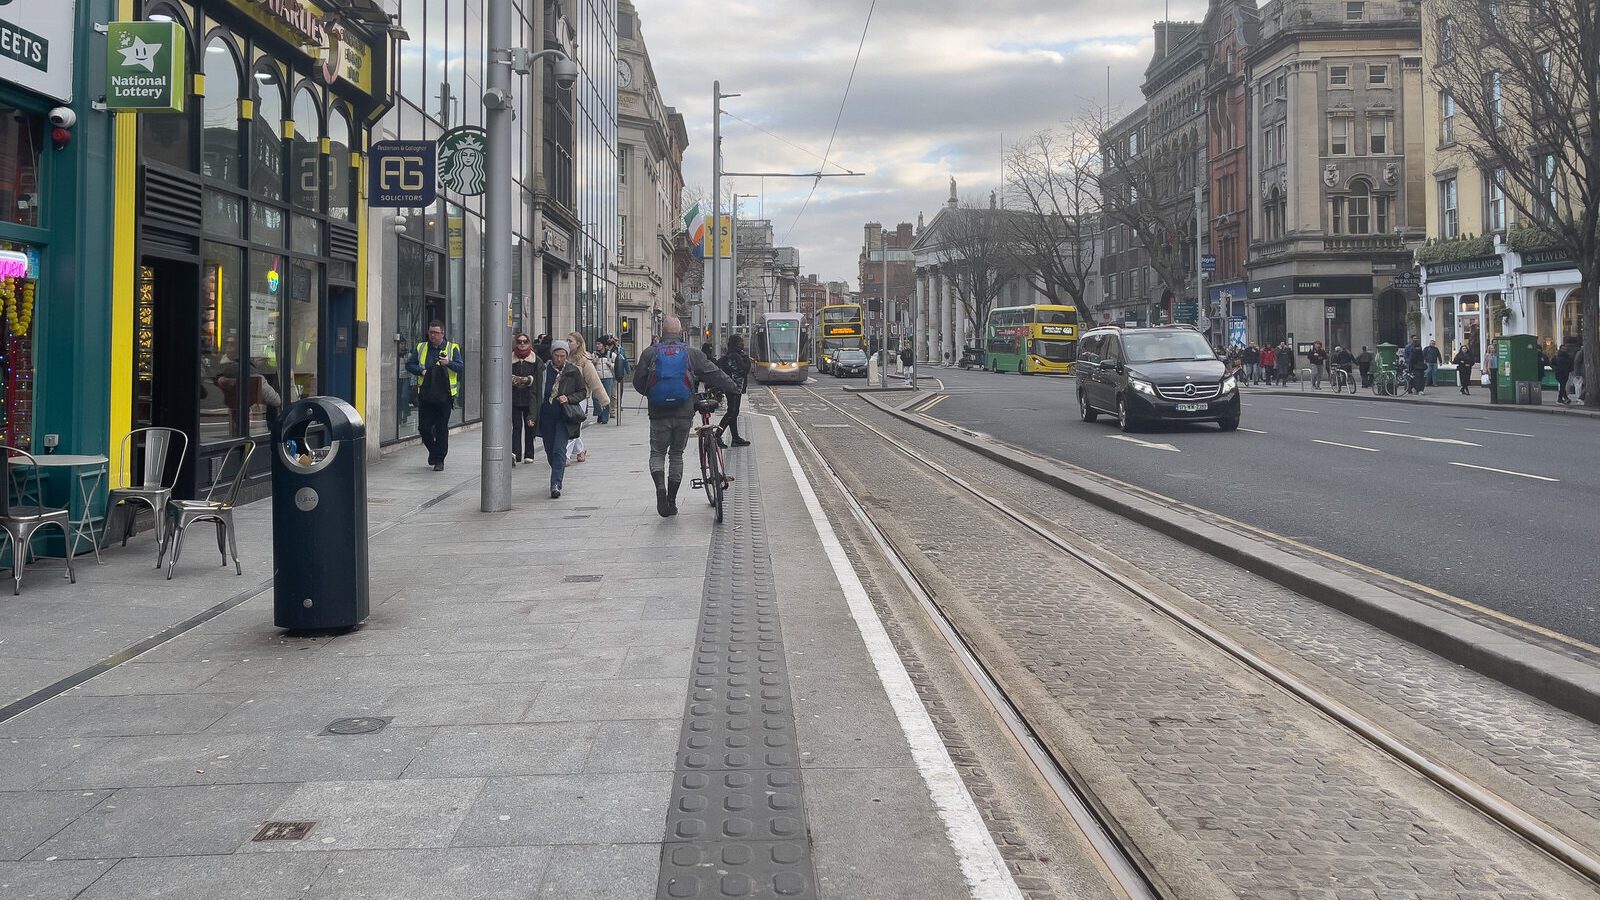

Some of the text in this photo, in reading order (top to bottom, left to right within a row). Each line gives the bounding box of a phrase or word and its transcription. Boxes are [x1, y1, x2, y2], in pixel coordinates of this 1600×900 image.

[0, 27, 42, 63] EETS
[112, 76, 166, 86] National
[115, 87, 162, 99] Lottery
[381, 156, 423, 190] AG
[707, 225, 728, 236] YS
